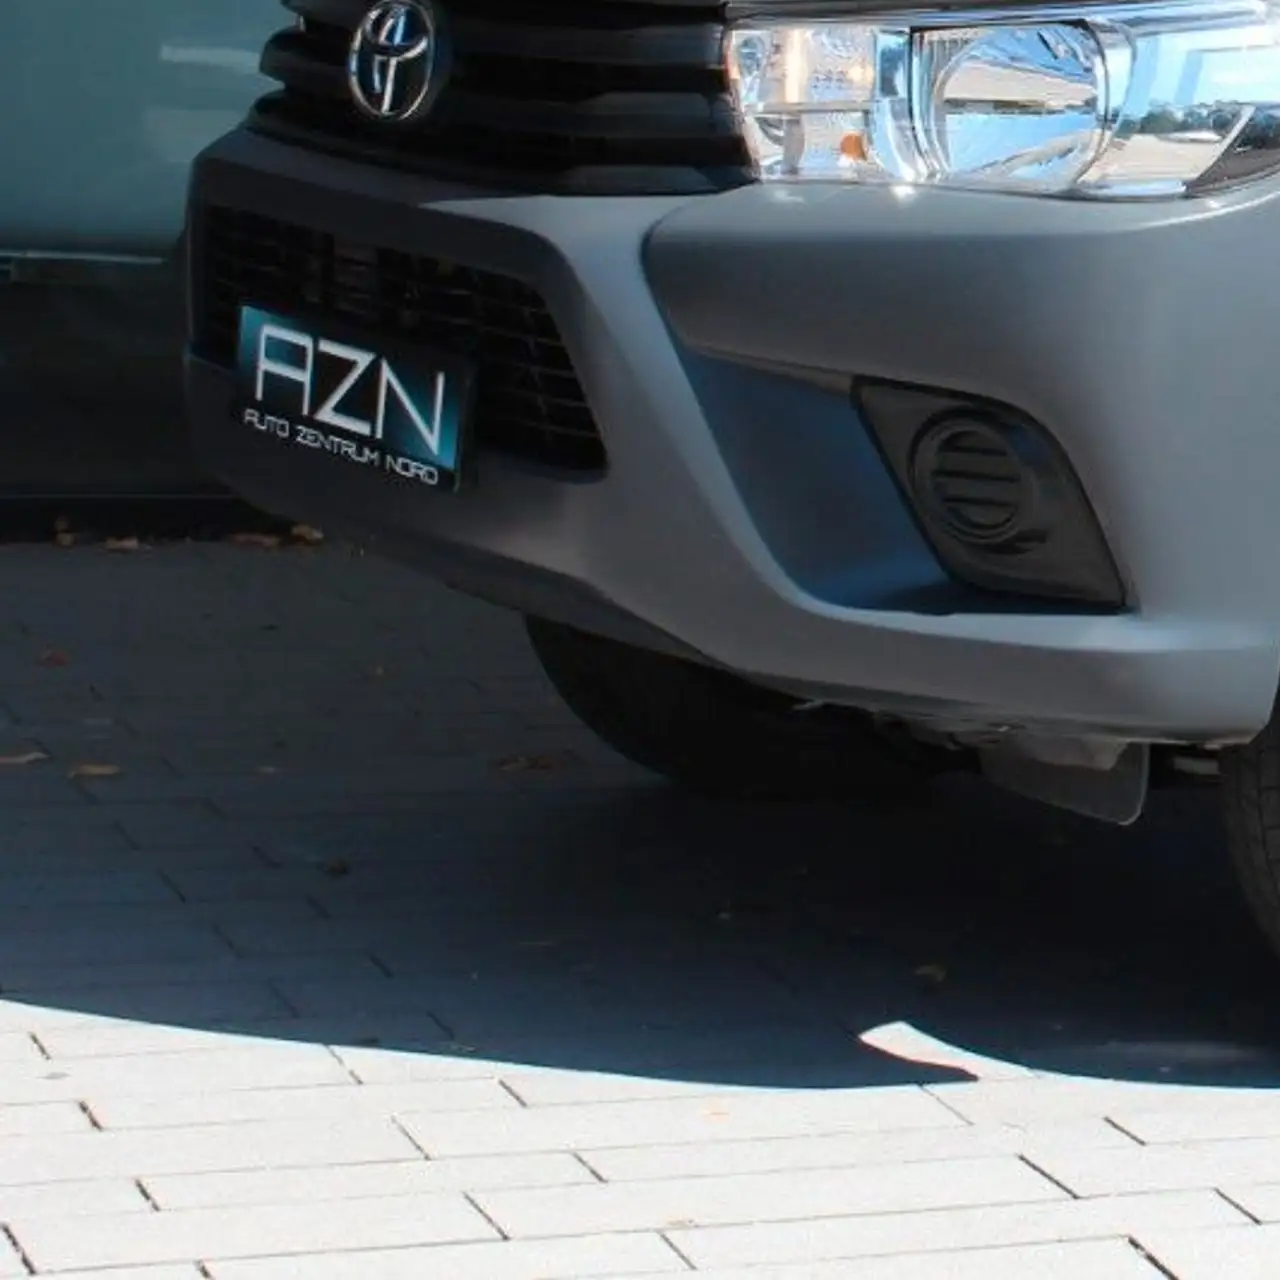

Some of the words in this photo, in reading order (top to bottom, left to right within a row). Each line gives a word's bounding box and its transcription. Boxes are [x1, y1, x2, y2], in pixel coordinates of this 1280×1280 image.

[254, 323, 445, 456] AZN
[243, 408, 290, 438] AUTO
[295, 424, 381, 467] ZENTRUM
[385, 454, 438, 485] NORD
